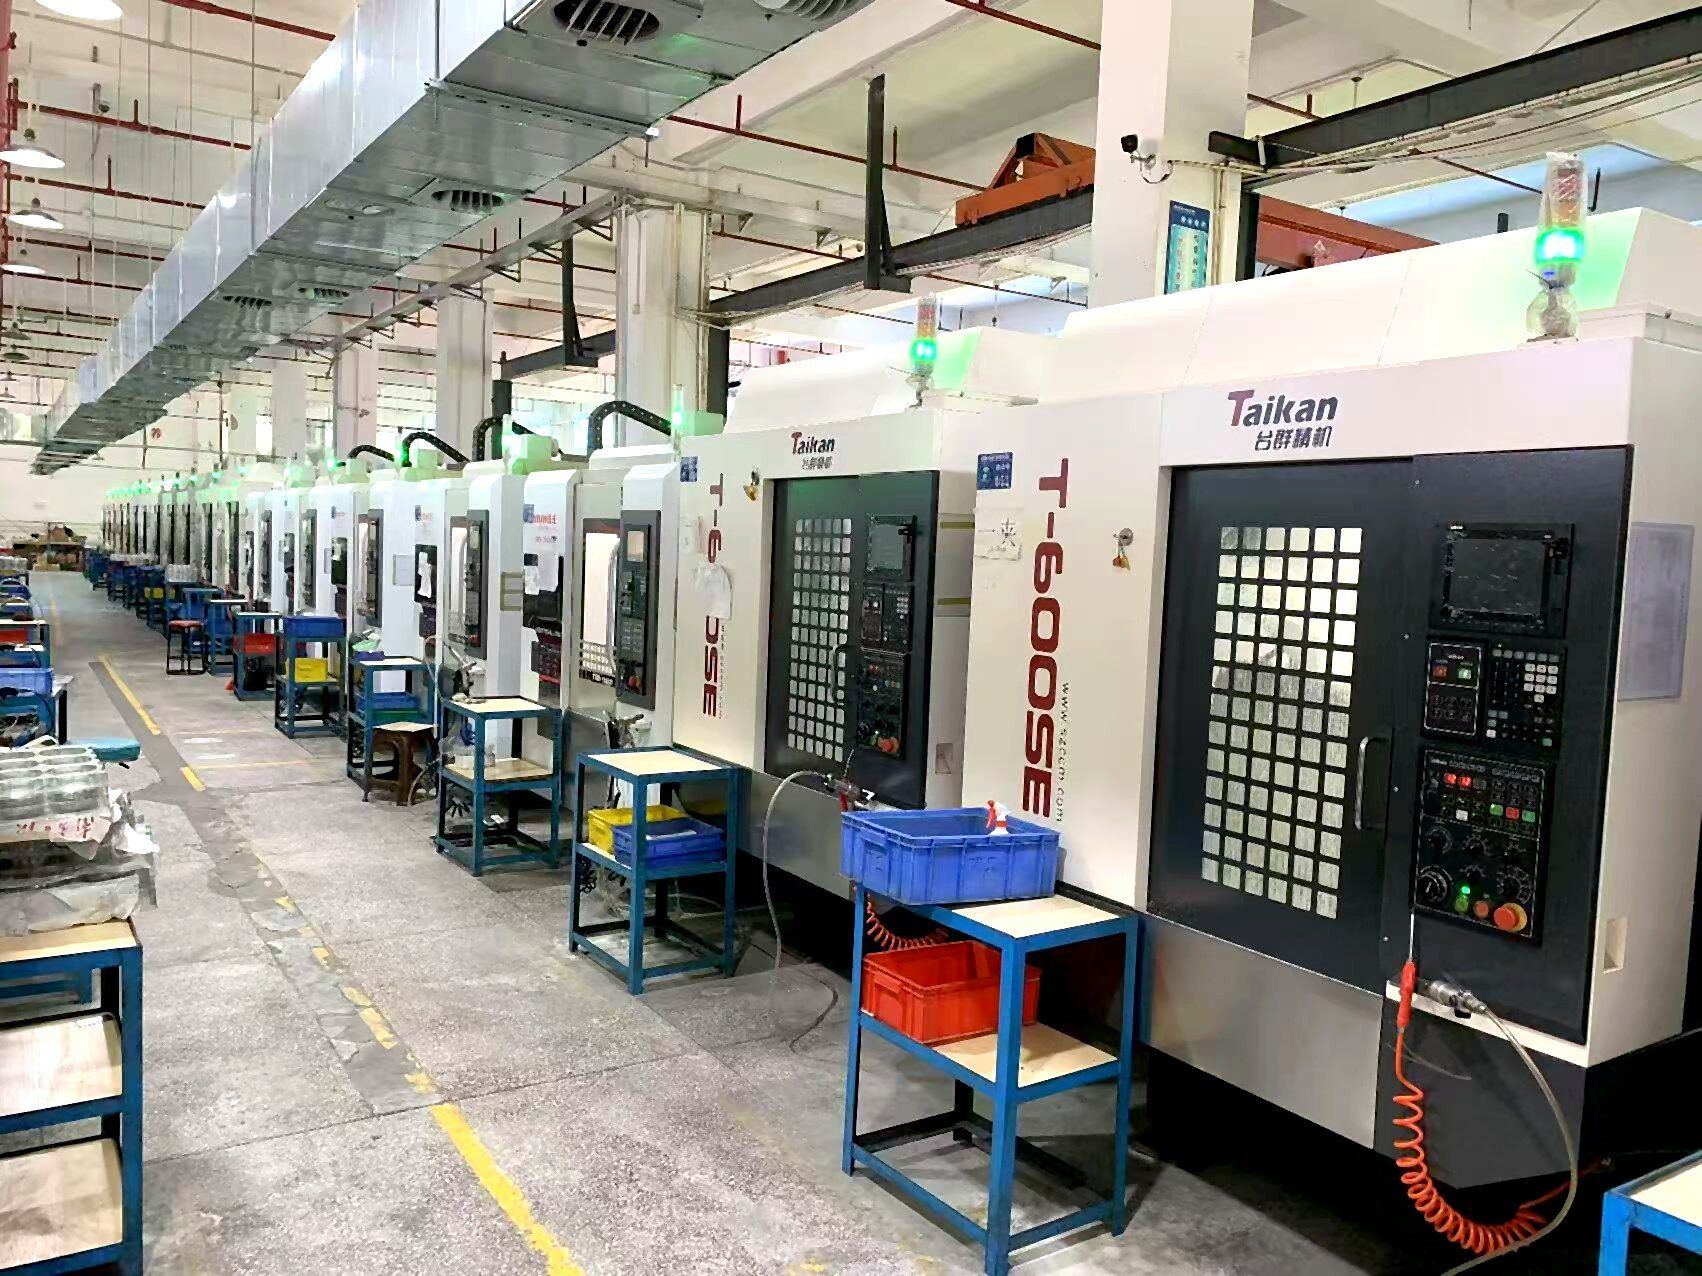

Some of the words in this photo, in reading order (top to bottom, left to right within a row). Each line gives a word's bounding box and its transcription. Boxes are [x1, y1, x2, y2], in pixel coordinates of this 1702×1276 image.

[1227, 388, 1338, 427] Taikan
[790, 431, 836, 455] Taikan
[1022, 457, 1070, 819] T-600SE
